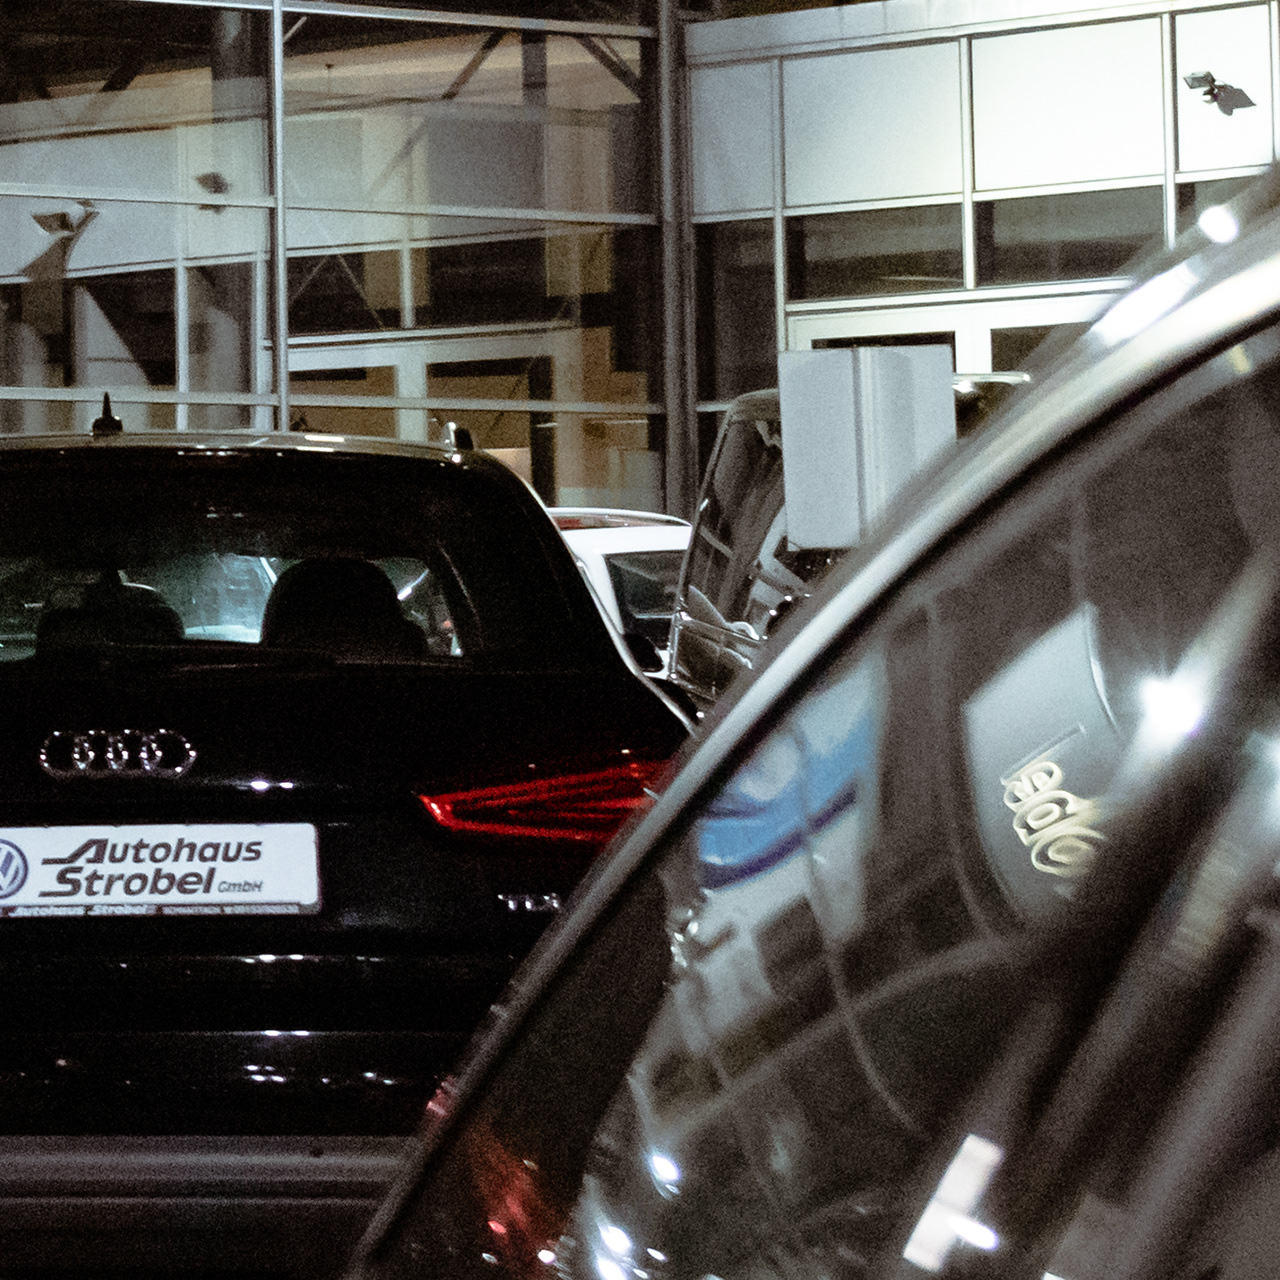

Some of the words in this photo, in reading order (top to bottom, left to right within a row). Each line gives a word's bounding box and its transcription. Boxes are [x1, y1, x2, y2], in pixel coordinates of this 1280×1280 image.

[41, 837, 263, 866] Autohaus
[38, 866, 216, 898] Strobel
[217, 879, 264, 894] GmbH
